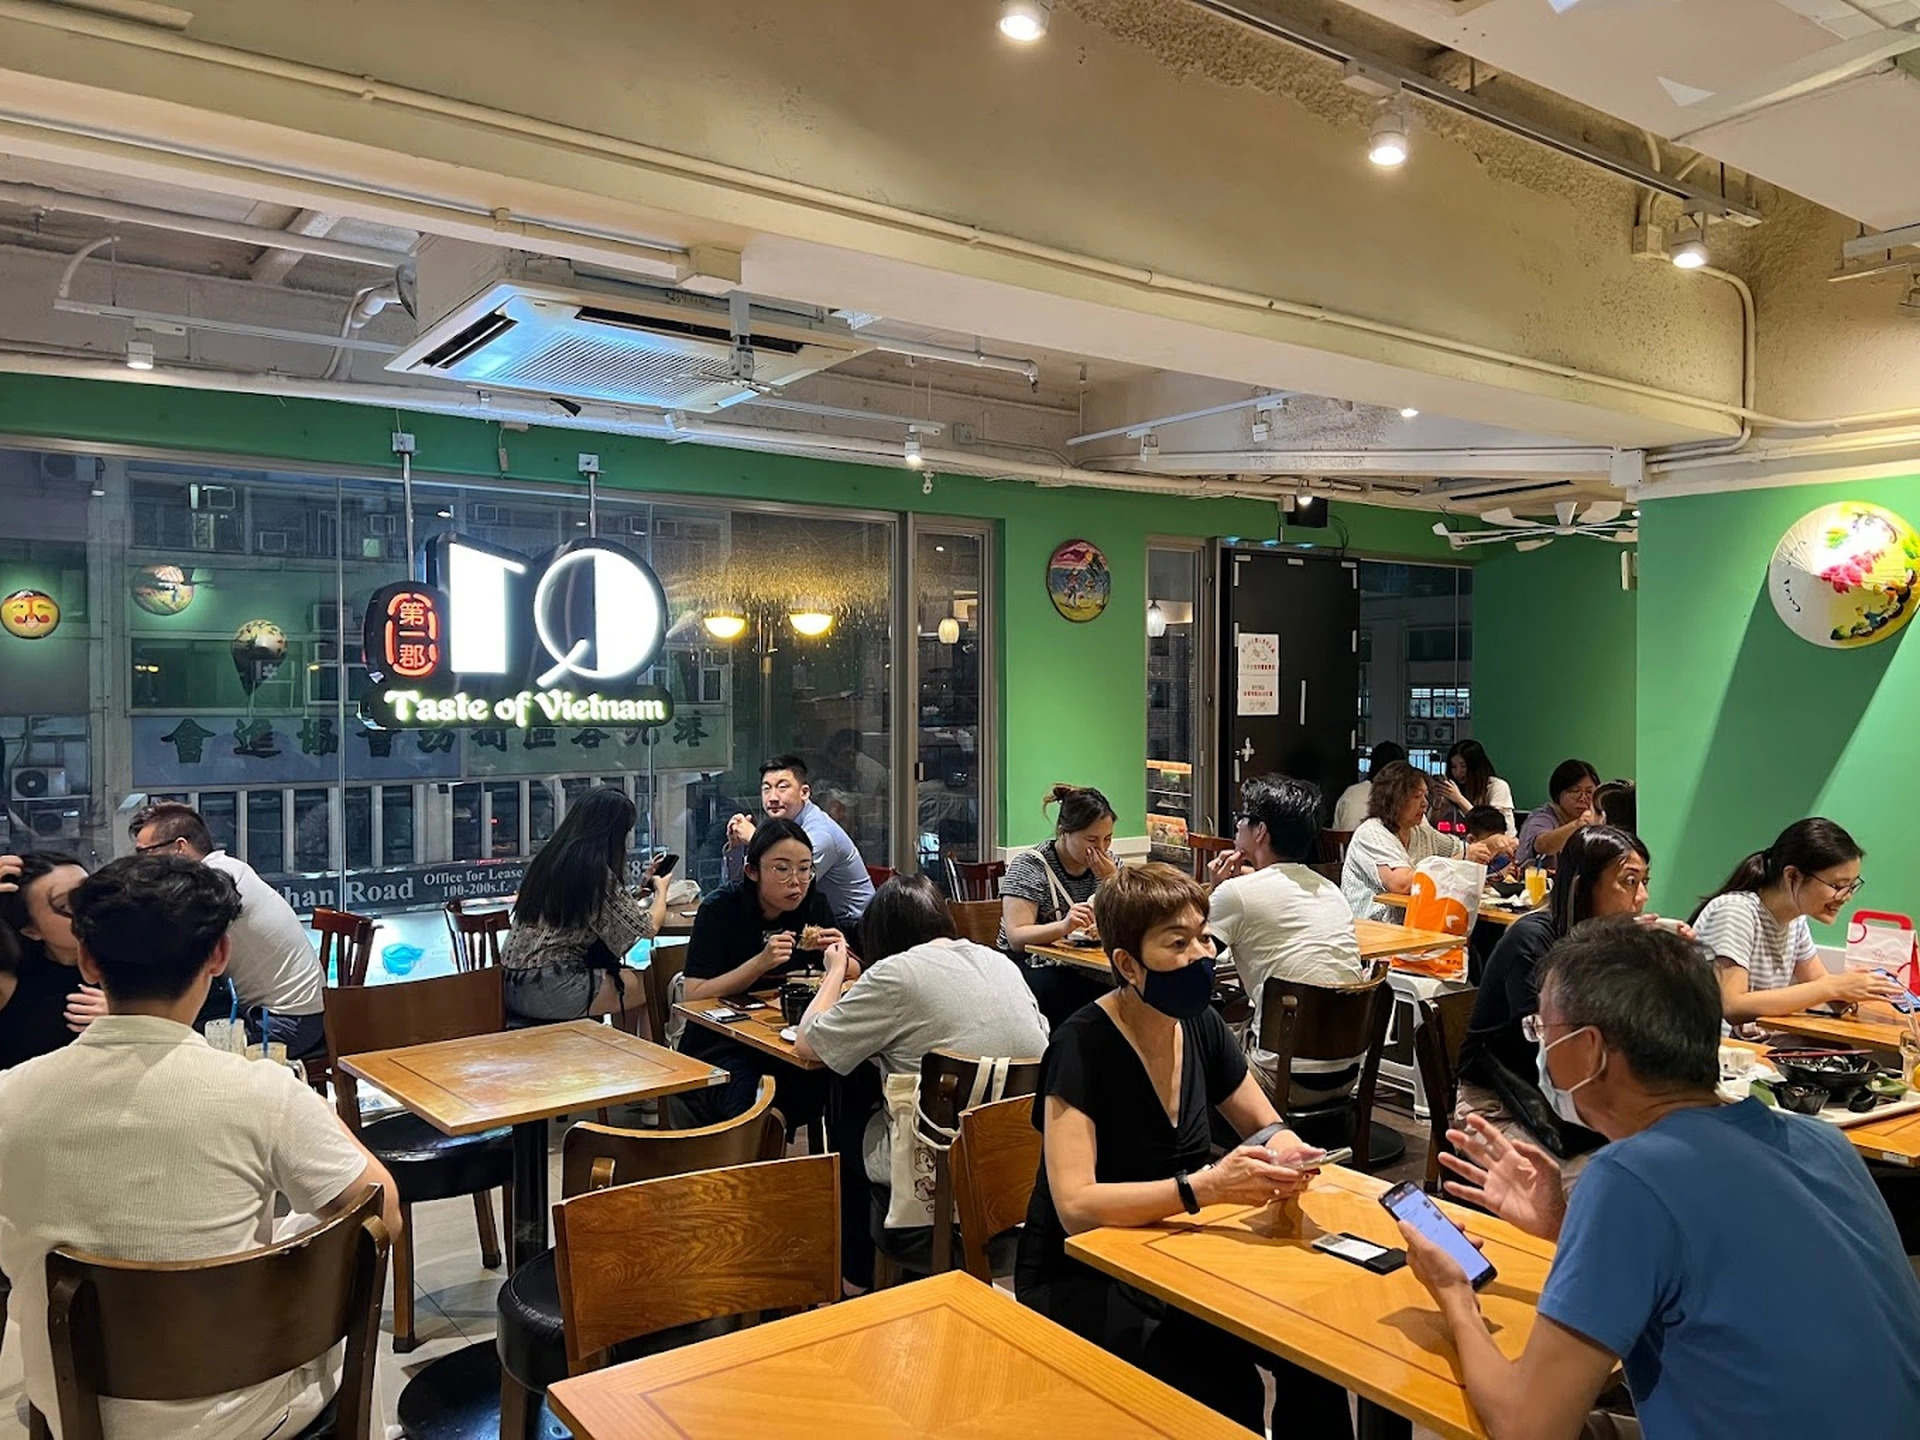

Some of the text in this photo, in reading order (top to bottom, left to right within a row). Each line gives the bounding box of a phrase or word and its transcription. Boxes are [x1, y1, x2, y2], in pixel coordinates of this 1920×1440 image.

[399, 601, 426, 669] 第一郡
[383, 687, 666, 729] Taste of Vietnam
[279, 876, 415, 908] han Road
[423, 868, 523, 886] Office for Lease
